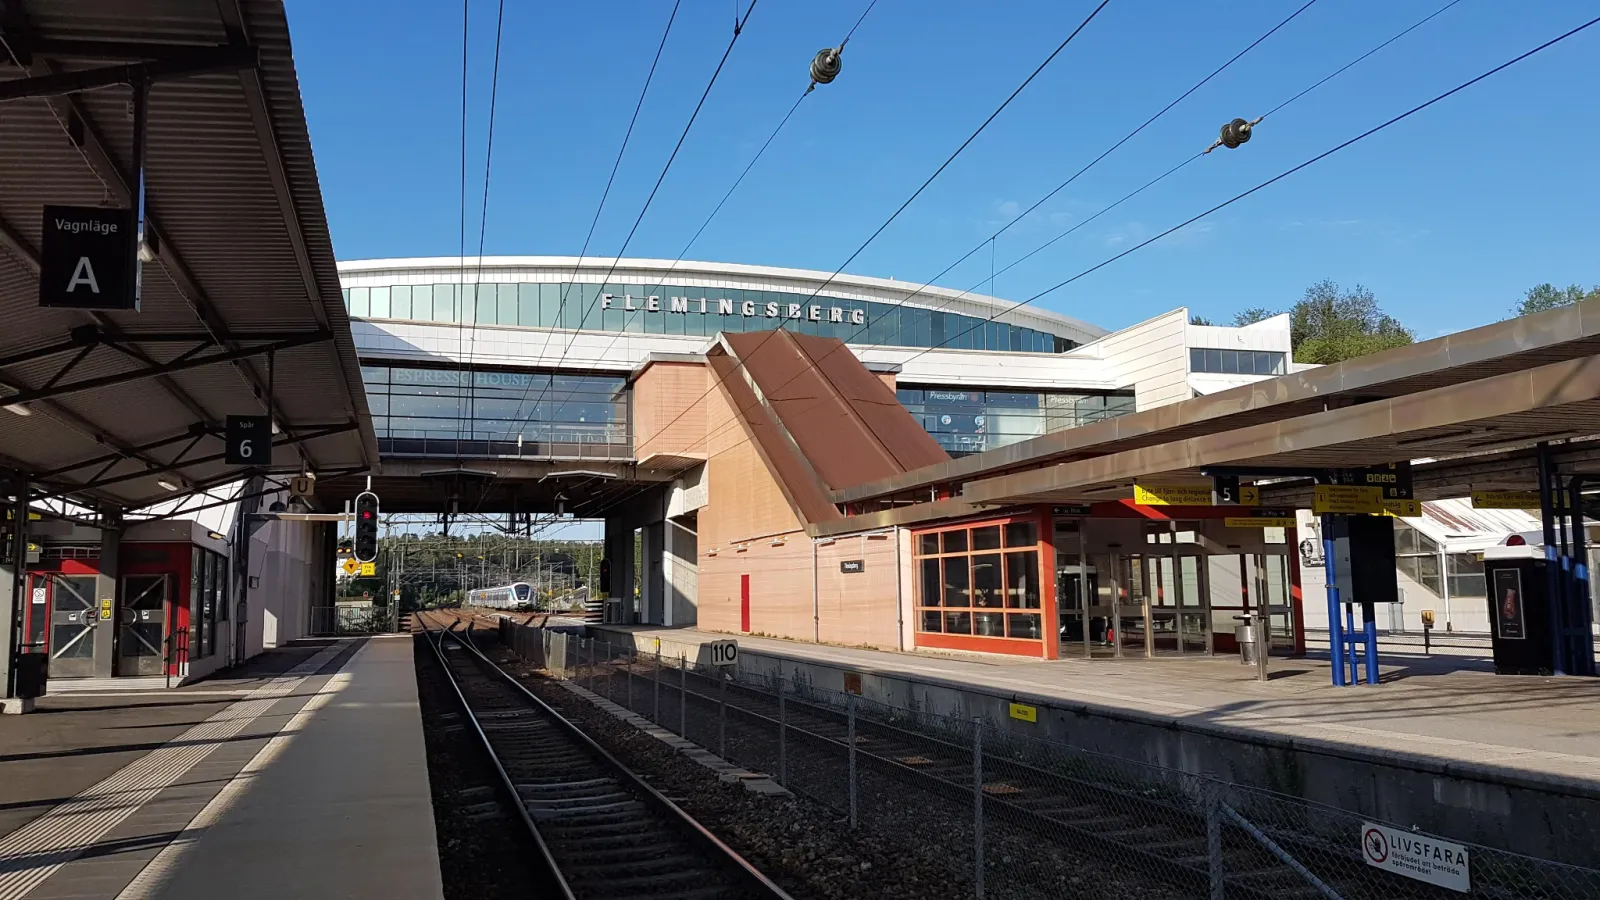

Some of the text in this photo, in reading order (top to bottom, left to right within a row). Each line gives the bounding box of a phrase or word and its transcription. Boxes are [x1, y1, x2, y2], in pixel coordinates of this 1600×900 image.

[55, 218, 118, 235] Vagnläge
[66, 256, 100, 293] A
[602, 293, 865, 324] FLEMINGSBERG
[395, 369, 530, 386] ESPRESSO HOUSE
[930, 391, 968, 401] Pressbyrån
[239, 421, 254, 429] Spår
[240, 440, 253, 457] 6
[298, 480, 308, 493] U
[1223, 488, 1231, 501] 5
[1425, 612, 1431, 621] U
[714, 644, 736, 661] 110
[1390, 835, 1466, 867] LIVSFARA
[1392, 851, 1460, 876] förbjudet att beträda
[1392, 859, 1432, 876] spårområdet
